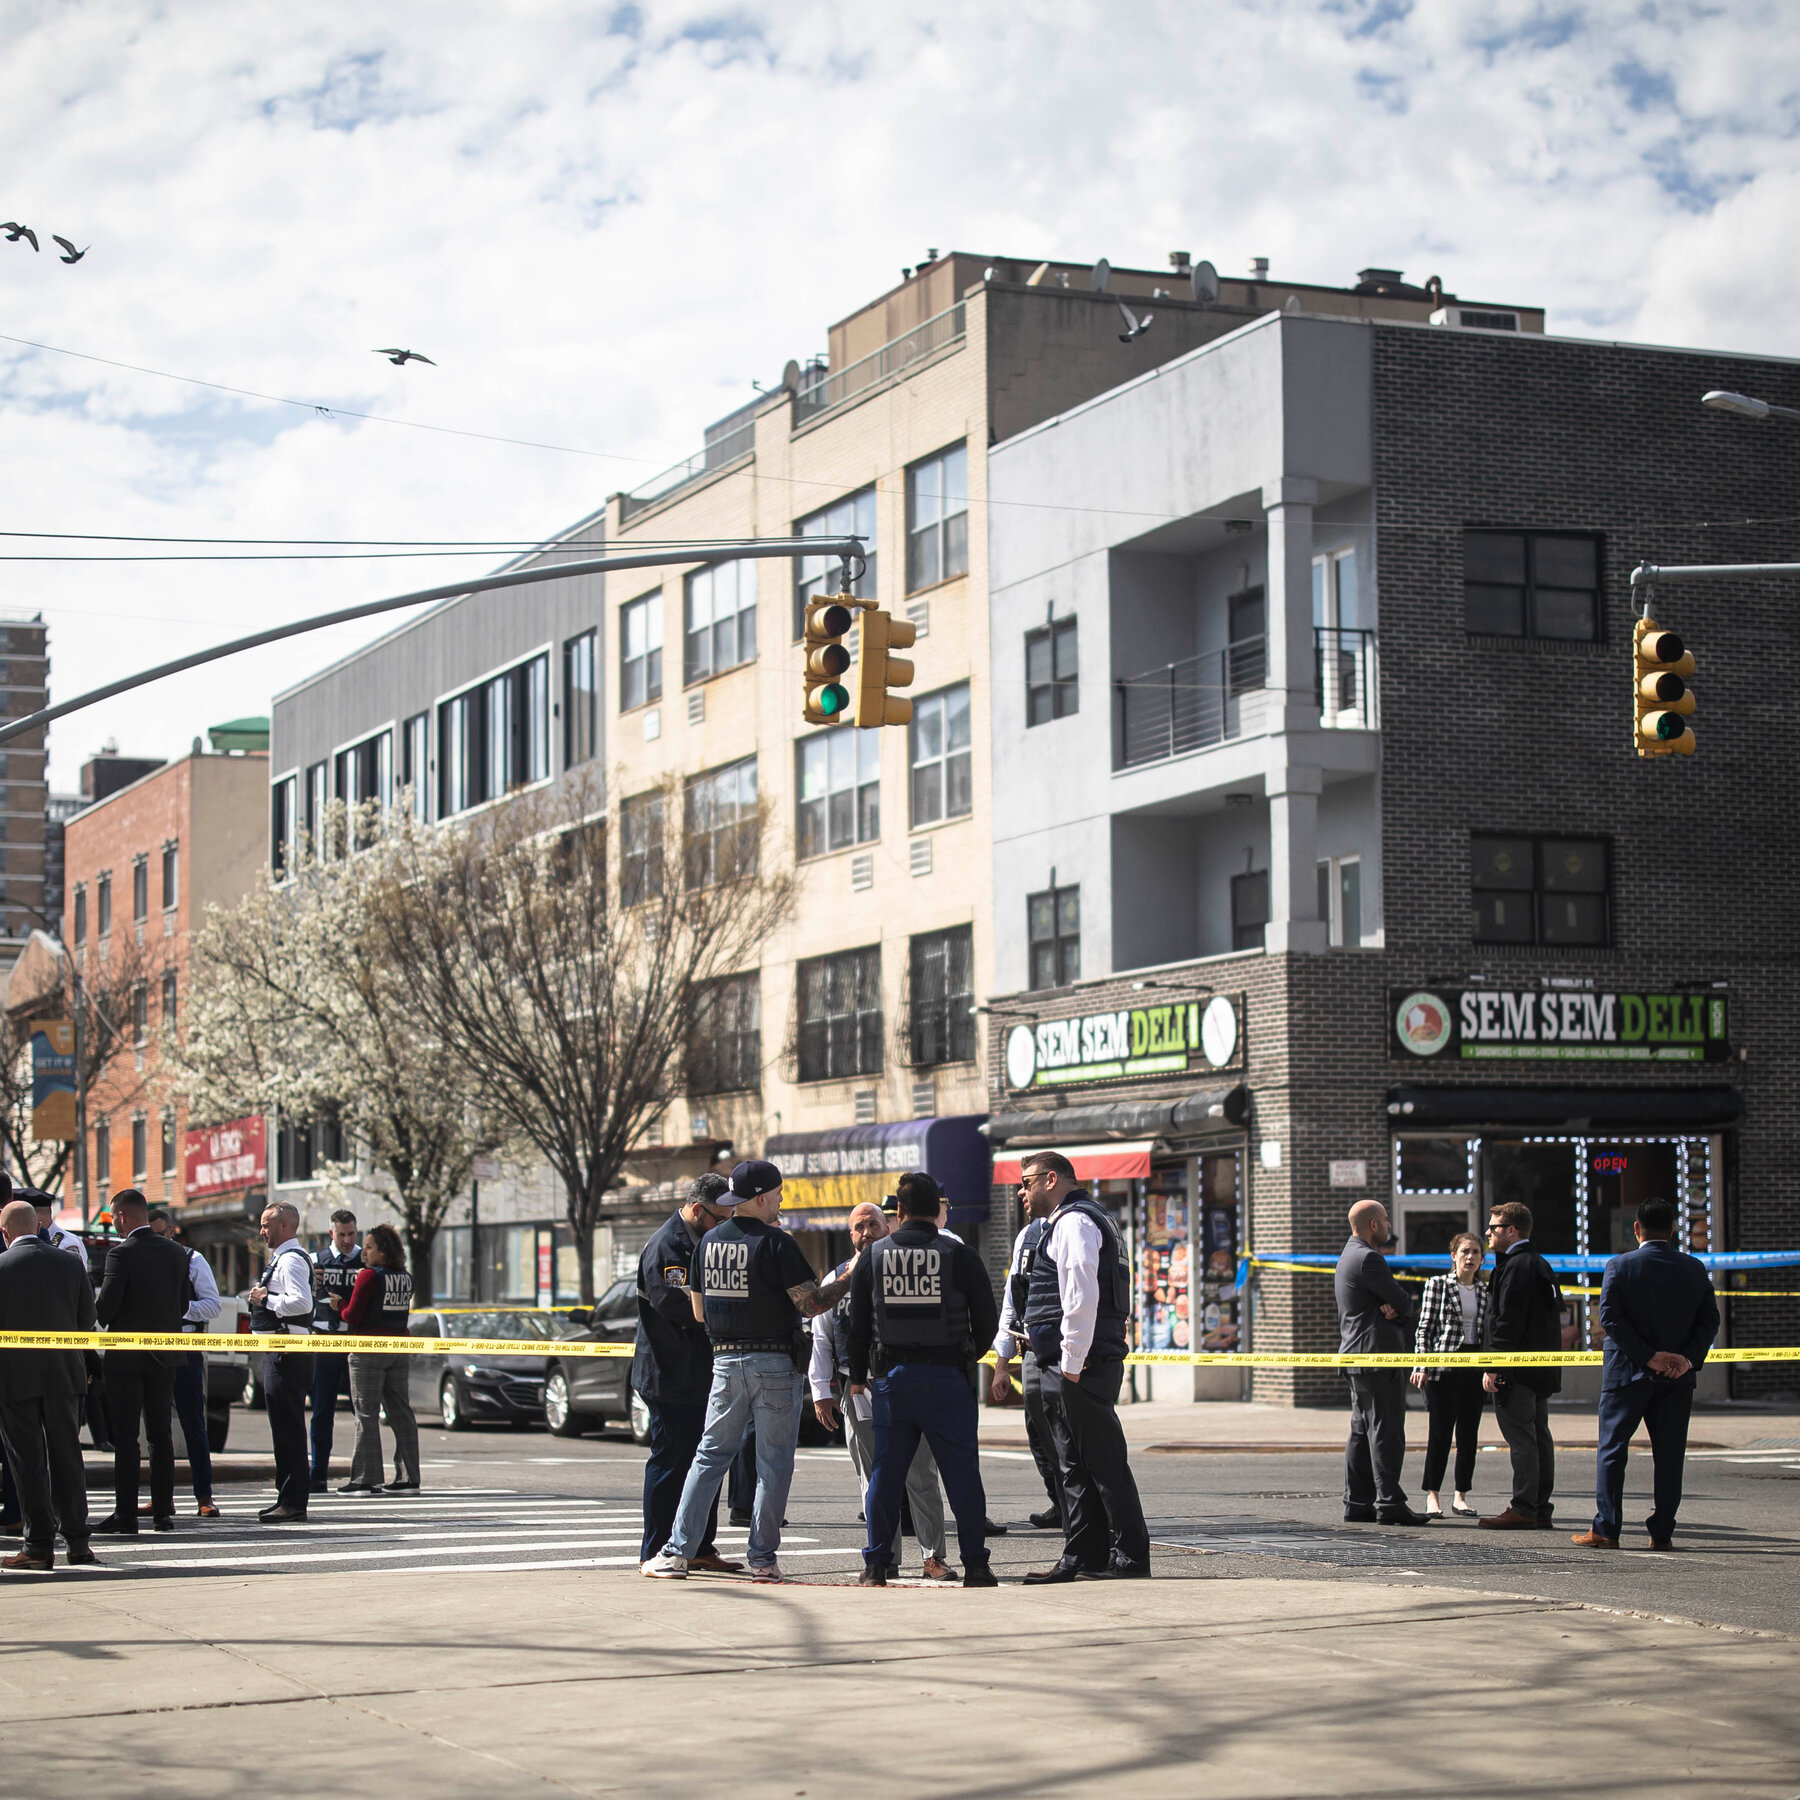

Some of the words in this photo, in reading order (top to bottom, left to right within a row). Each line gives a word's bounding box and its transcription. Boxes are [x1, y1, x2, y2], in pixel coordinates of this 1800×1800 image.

[1460, 992, 1536, 1040] SEM
[1541, 993, 1616, 1041] SEM
[1620, 995, 1705, 1042] DELI
[1036, 1018, 1081, 1069] SEM
[1082, 1011, 1130, 1062] SEM
[1131, 1004, 1186, 1056] DELI
[840, 1148, 882, 1172] DAYCARE
[885, 1145, 920, 1168] CENTER
[1594, 1157, 1628, 1170] OPEN
[704, 1242, 748, 1269] NYPD
[882, 1249, 941, 1275] NYPD
[323, 1273, 356, 1286] POLIC
[385, 1274, 412, 1292] NYPD
[704, 1269, 749, 1290] POLICE
[883, 1275, 941, 1296] POLICE
